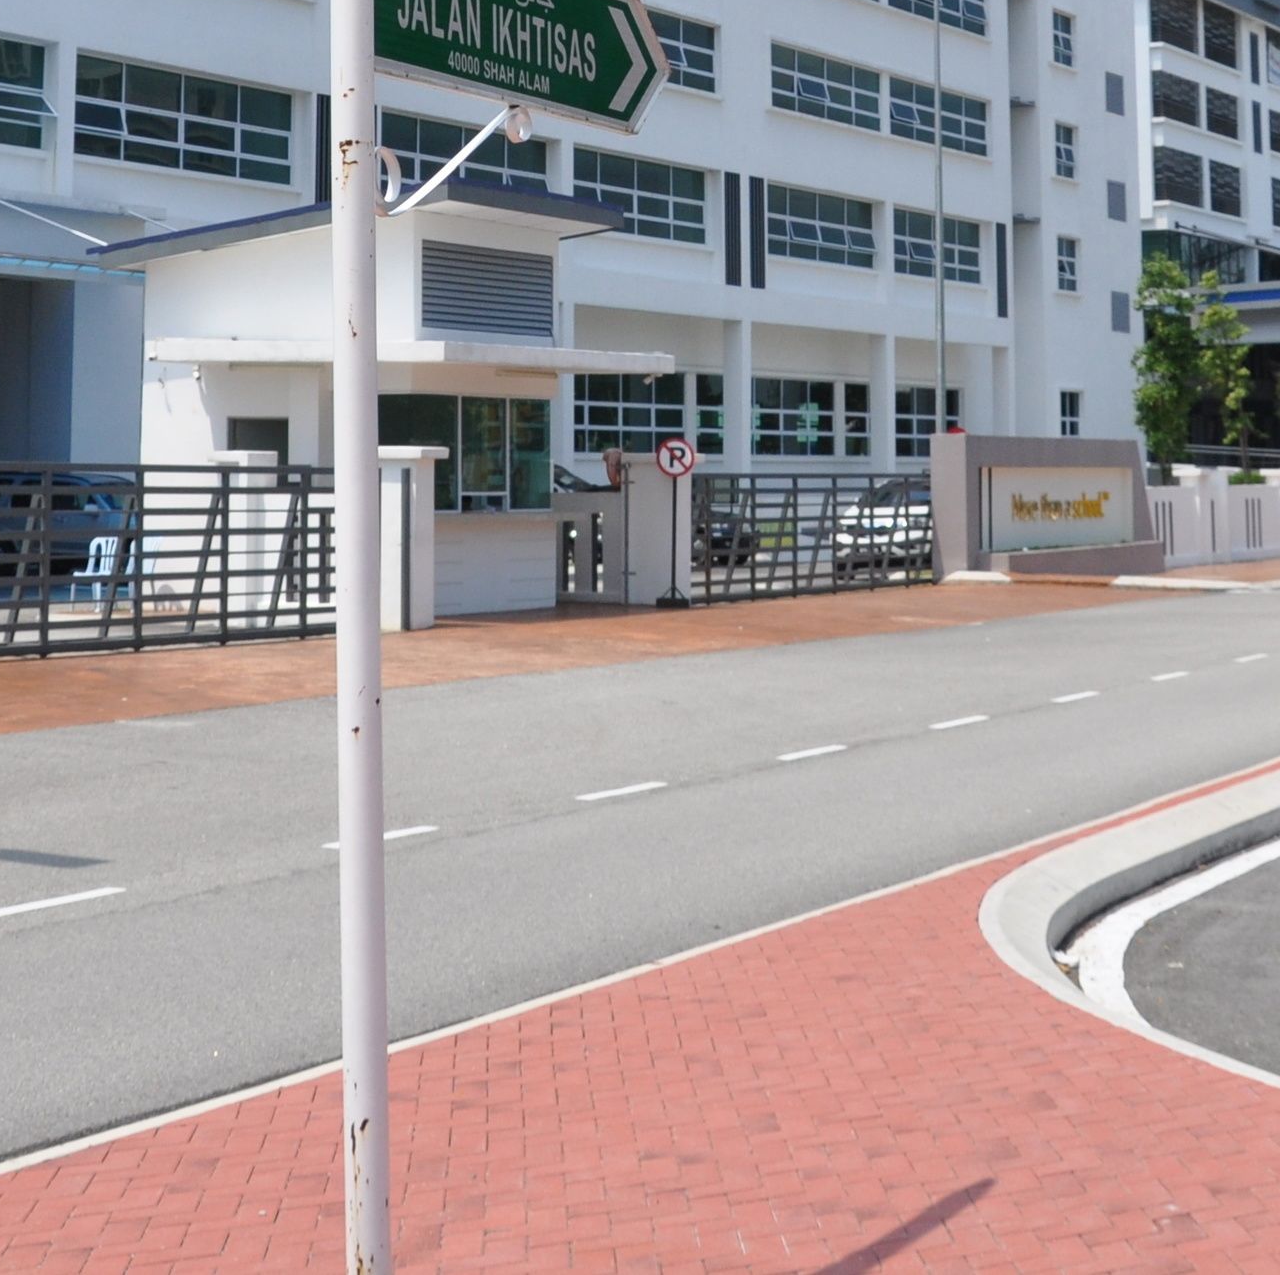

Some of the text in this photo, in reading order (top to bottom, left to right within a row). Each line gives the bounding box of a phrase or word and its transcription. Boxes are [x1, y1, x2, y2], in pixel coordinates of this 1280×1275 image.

[447, 50, 551, 95] 40000 SHAH ALAM
[492, 3, 597, 82] IKHTISAS
